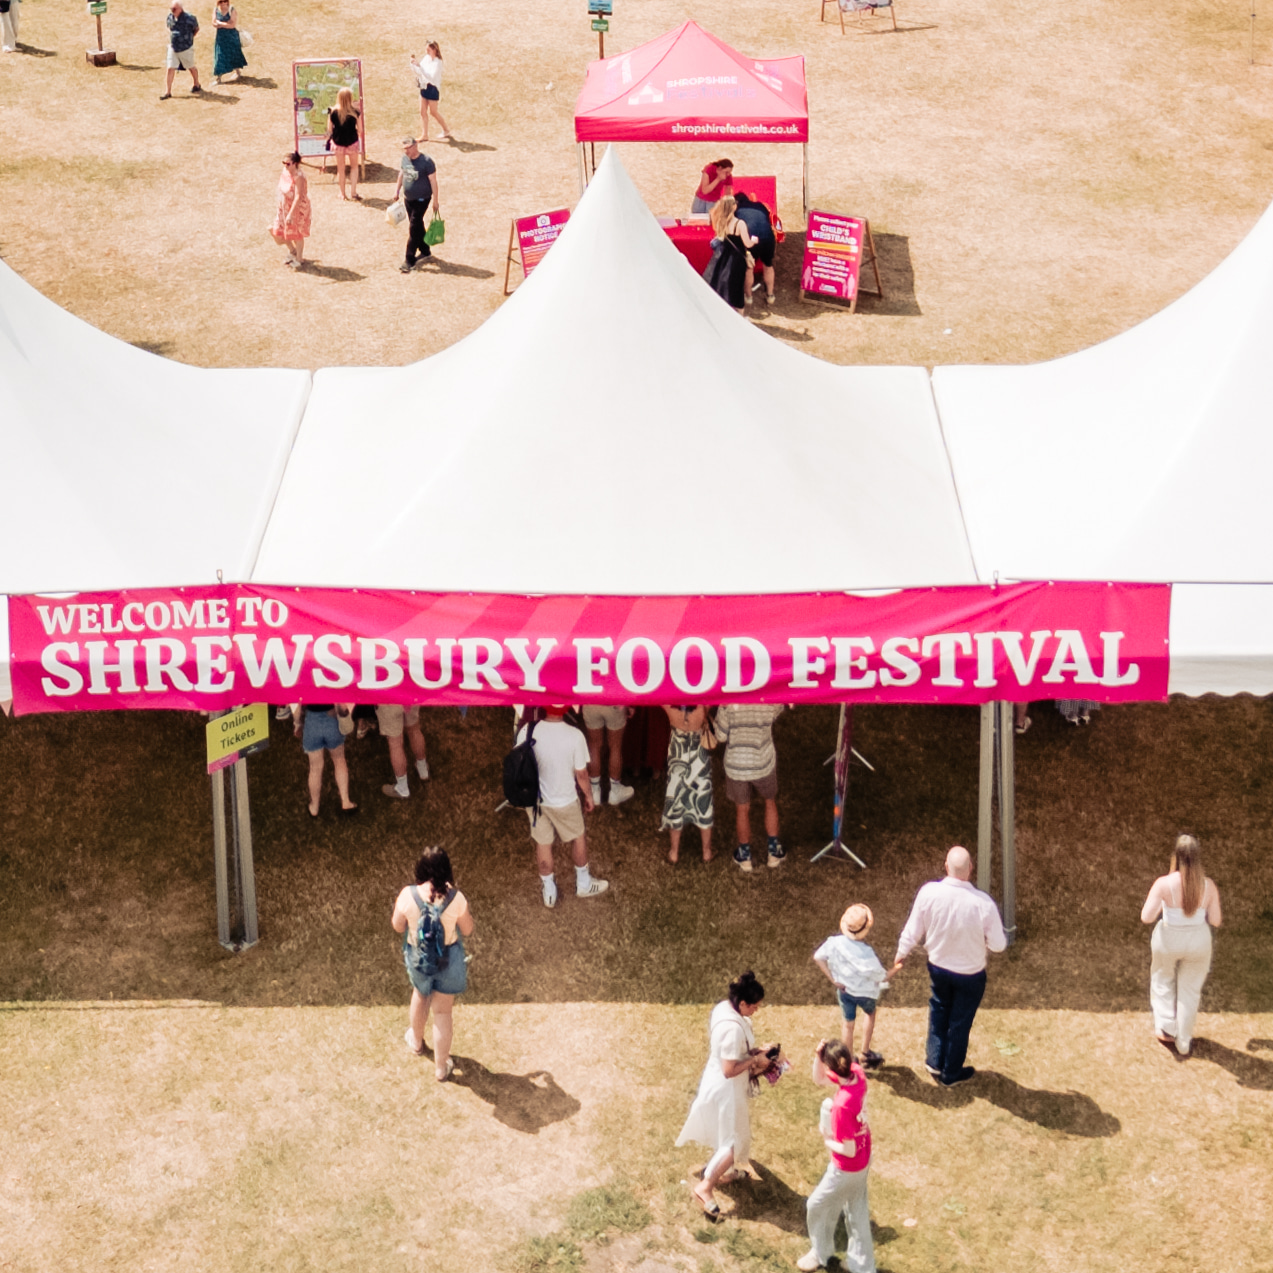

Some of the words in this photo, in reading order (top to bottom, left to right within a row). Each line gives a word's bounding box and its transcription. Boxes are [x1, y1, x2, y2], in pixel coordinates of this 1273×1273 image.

[667, 76, 738, 88] SHROPSHIRE
[666, 86, 757, 100] Festivals
[671, 123, 799, 136] shropshirefestivals.co.uk
[811, 229, 858, 245] WRISTBAND
[820, 224, 850, 236] CHILD'S
[37, 599, 230, 636] WELCOME
[237, 596, 288, 628] TO
[40, 632, 559, 697] SHREWSBURY
[572, 636, 772, 695] FOOD
[787, 628, 1141, 689] FESTIVAL
[221, 712, 254, 733] Online
[220, 727, 256, 750] Tickets
